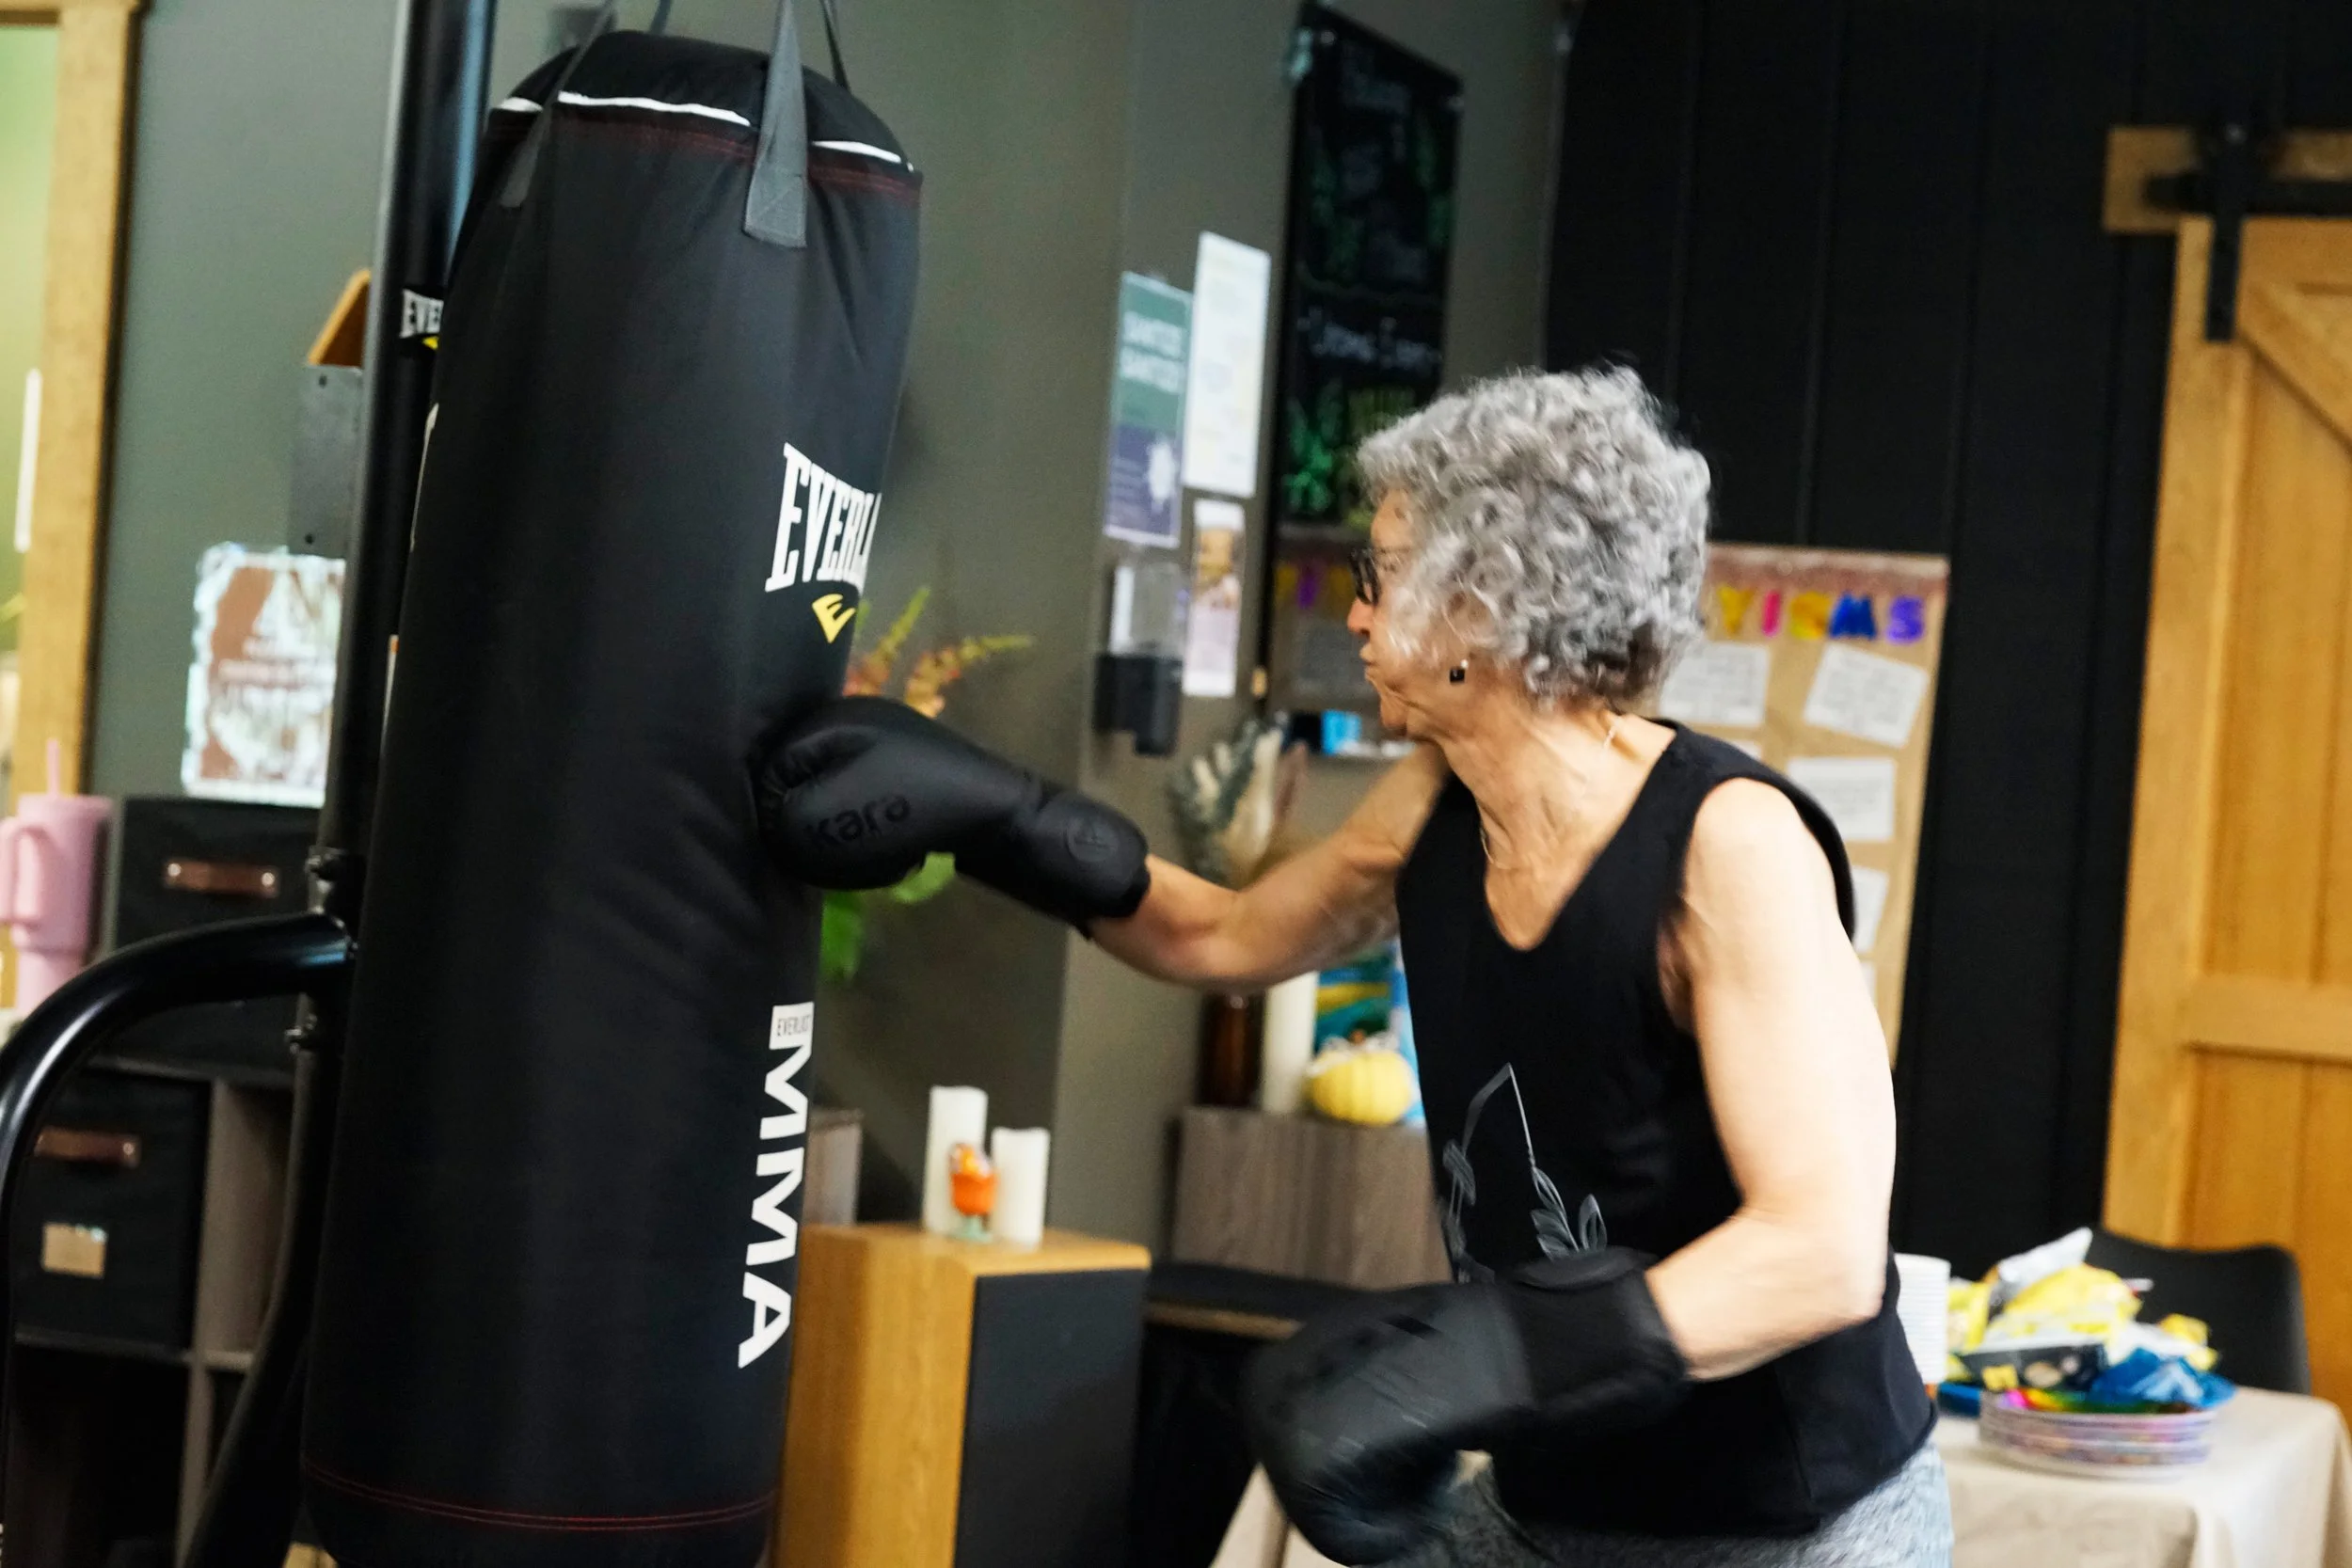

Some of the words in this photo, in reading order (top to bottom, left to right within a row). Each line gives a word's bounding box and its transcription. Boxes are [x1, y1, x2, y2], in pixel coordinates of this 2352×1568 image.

[399, 289, 444, 340] EVE
[765, 442, 882, 594] EVERL
[777, 1014, 812, 1037] EVERLA
[739, 1001, 815, 1369] MMA
